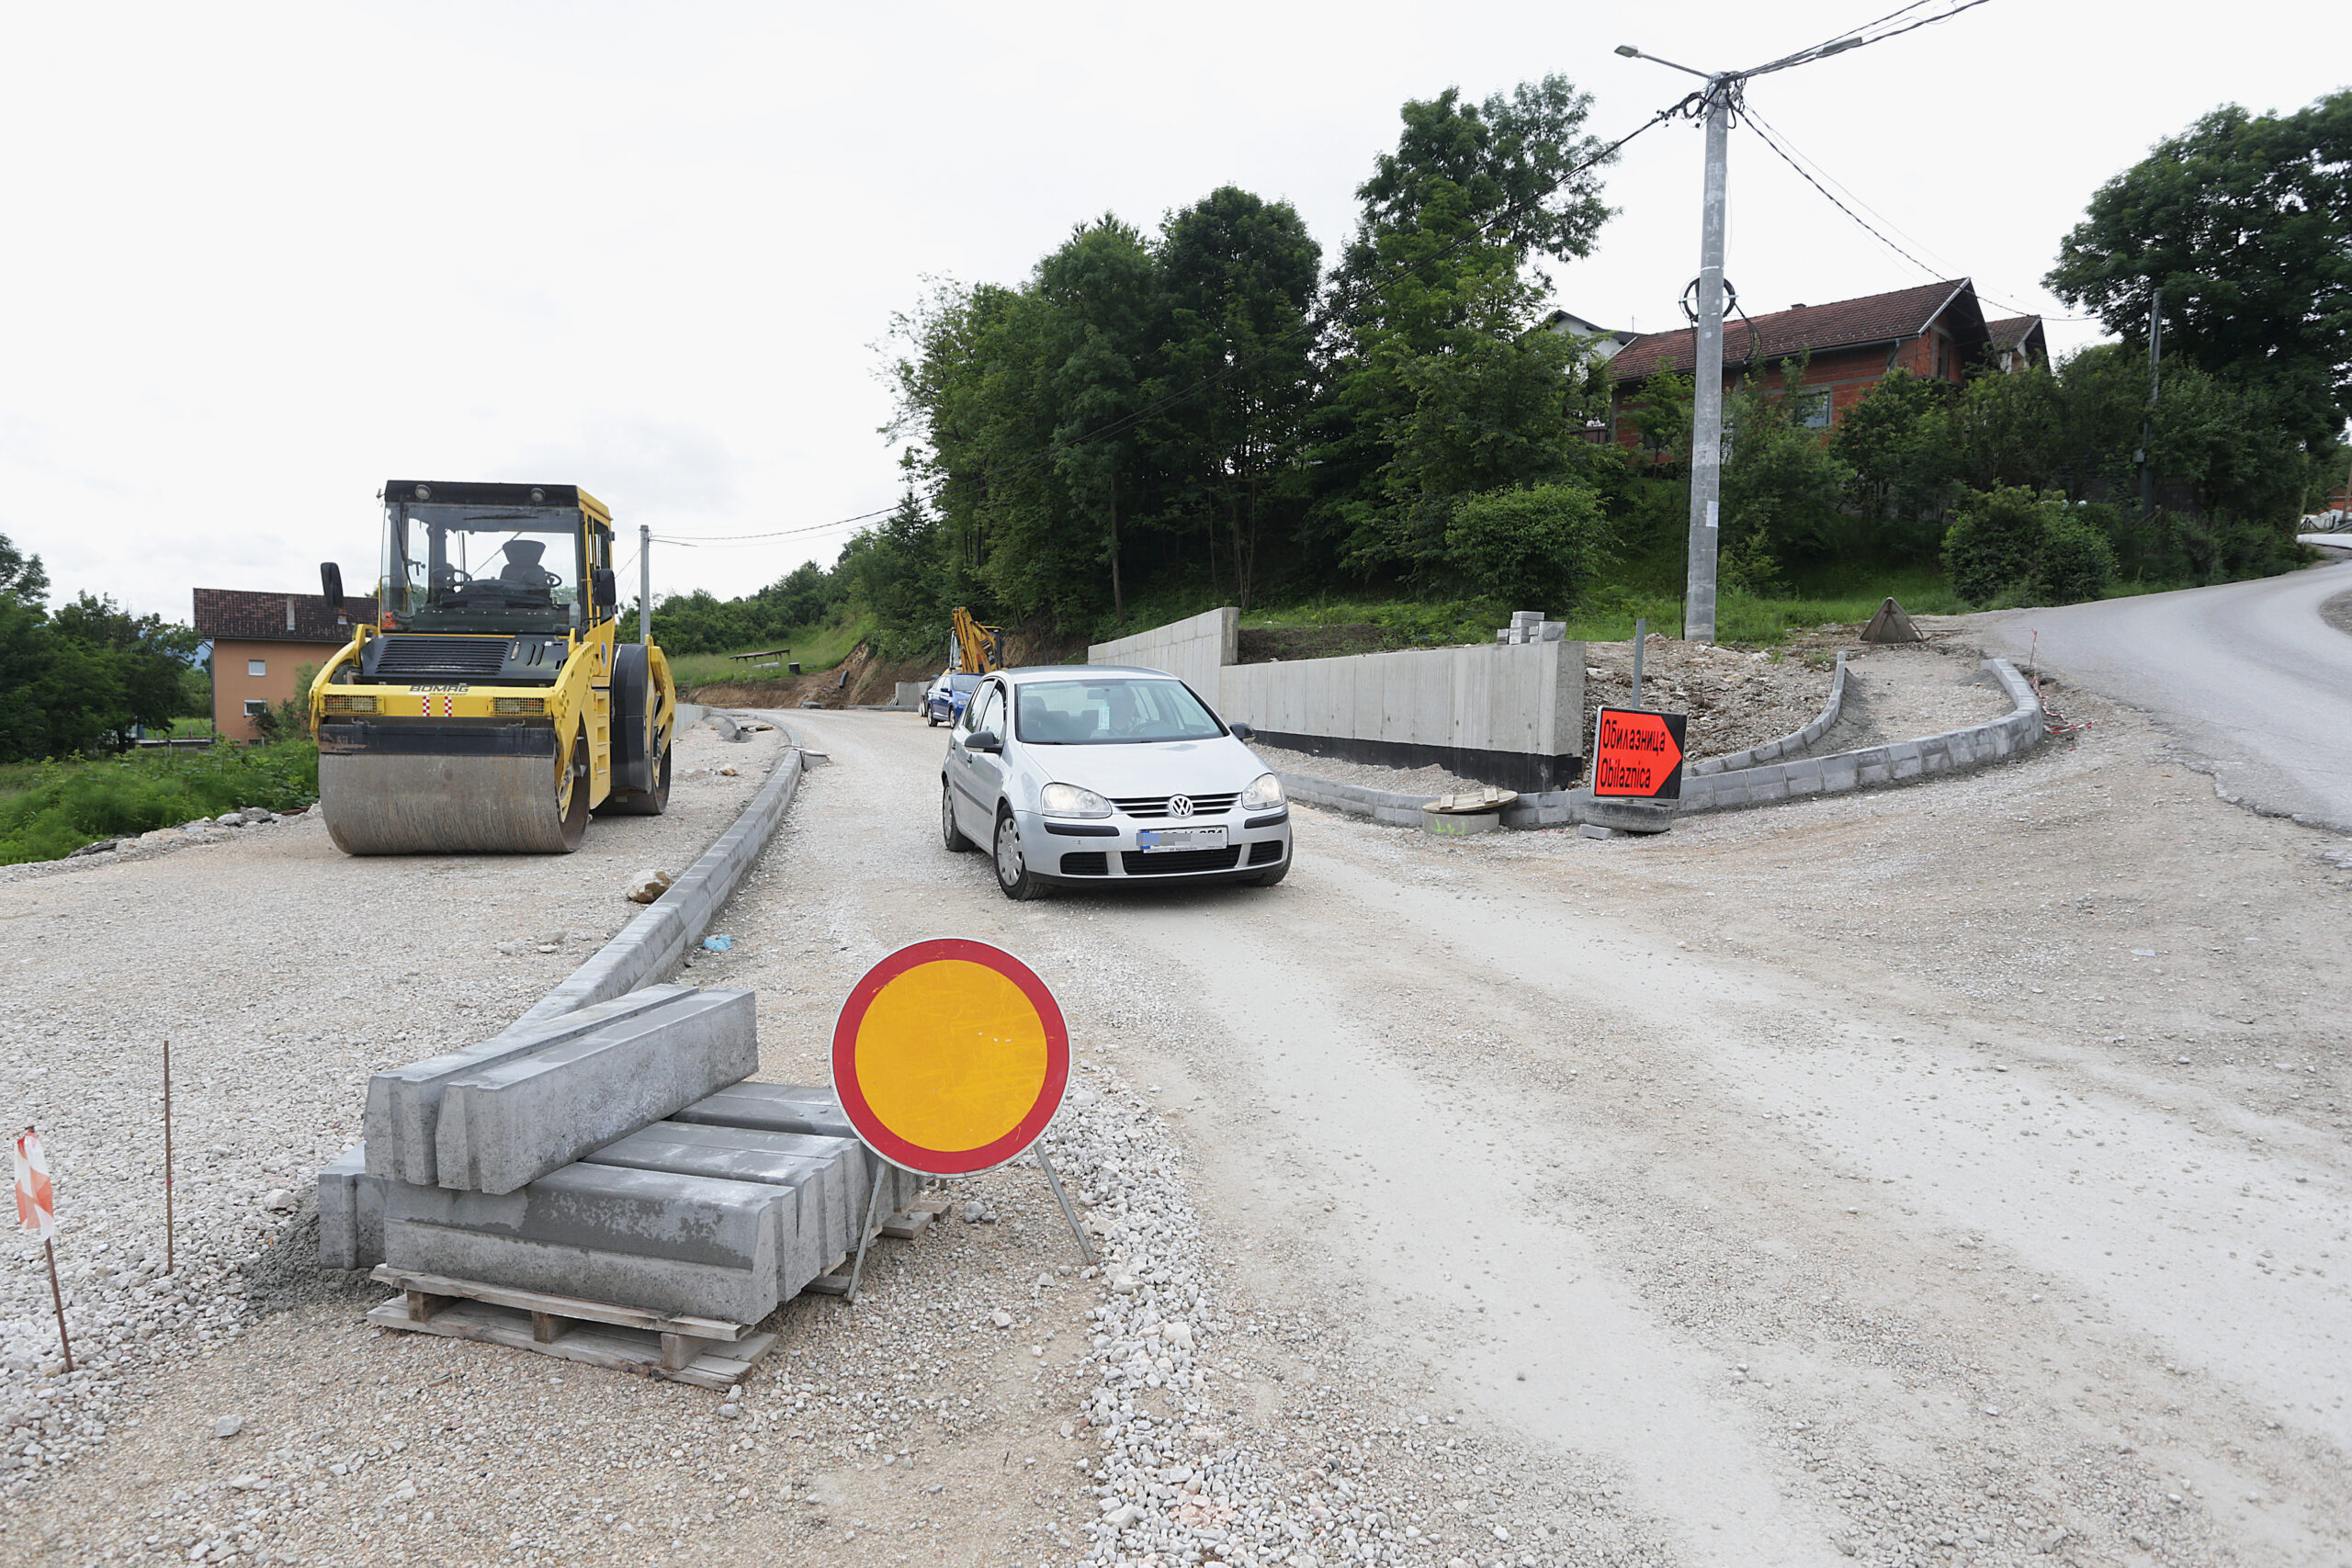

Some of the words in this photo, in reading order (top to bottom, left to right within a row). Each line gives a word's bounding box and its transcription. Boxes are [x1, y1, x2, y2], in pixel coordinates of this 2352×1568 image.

[410, 684, 469, 693] BOMAG
[1602, 719, 1666, 756] Обилазница
[1600, 758, 1651, 788] Obilaznica
